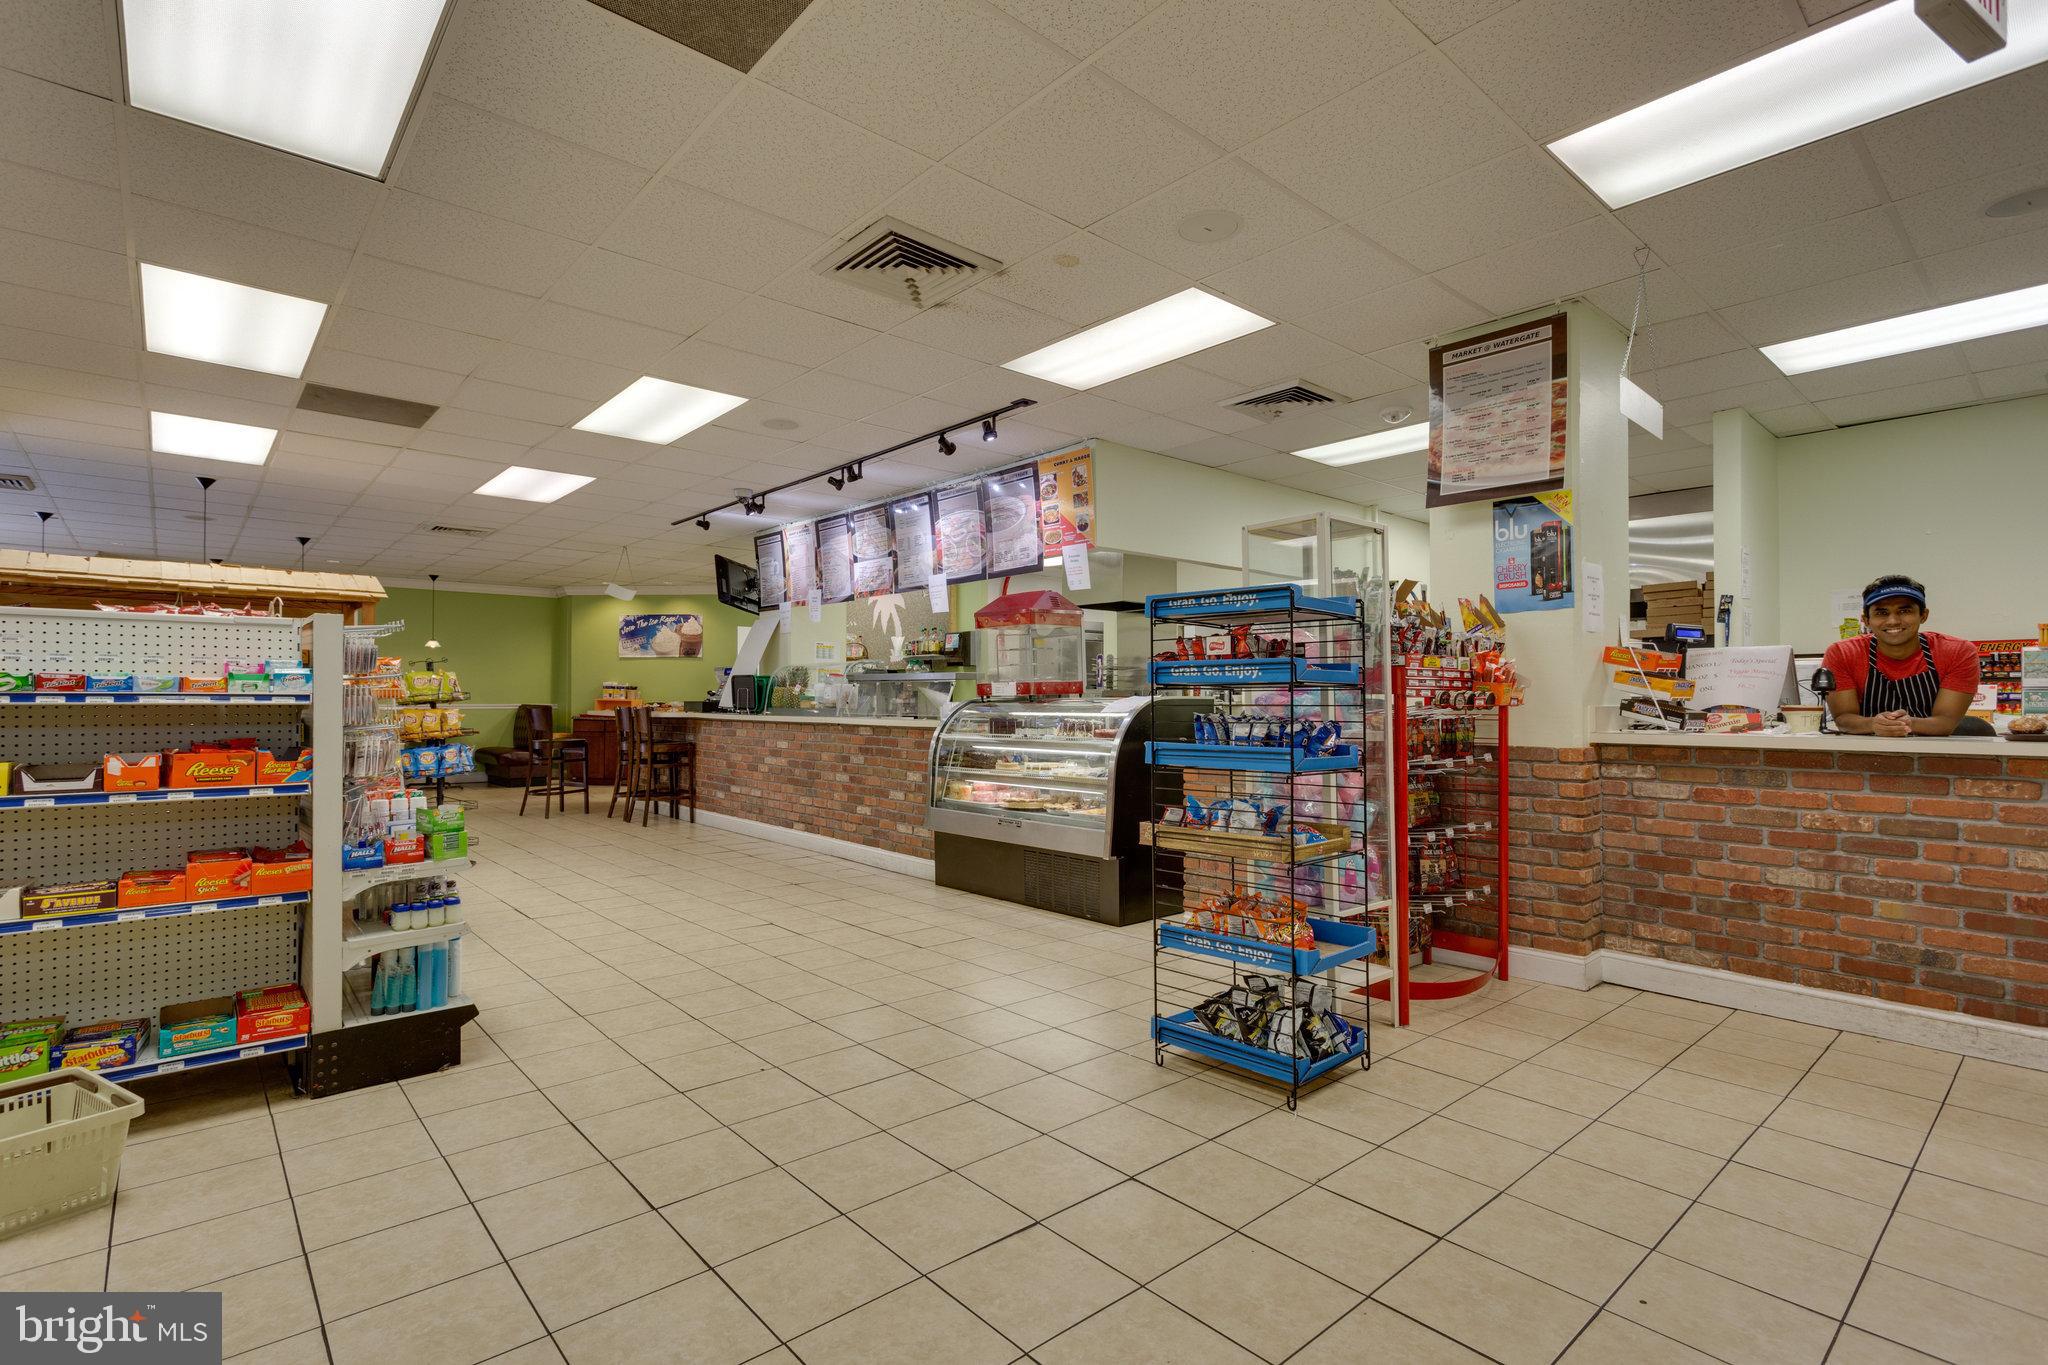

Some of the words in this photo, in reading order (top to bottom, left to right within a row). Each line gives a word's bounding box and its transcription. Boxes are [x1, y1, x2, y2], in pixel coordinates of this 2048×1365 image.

[1451, 346, 1483, 359] MARKET
[1493, 331, 1541, 349] WATERGATE
[1495, 518, 1528, 541] blu
[1496, 563, 1527, 574] CHERRY
[1497, 572, 1527, 581] CRUSH
[1225, 665, 1262, 679] Enjoy.
[43, 679, 77, 688] Trident
[93, 679, 126, 689] Trident
[191, 681, 218, 689] Trident
[185, 761, 241, 777] Reese's
[350, 848, 375, 859] HALLS
[393, 844, 417, 852] HALLS
[55, 895, 102, 907] AVENUE
[1238, 945, 1276, 965] Enjoy.
[255, 1015, 293, 1028] Starburst
[172, 1028, 212, 1043] Starburst
[63, 1044, 120, 1067] Starburst
